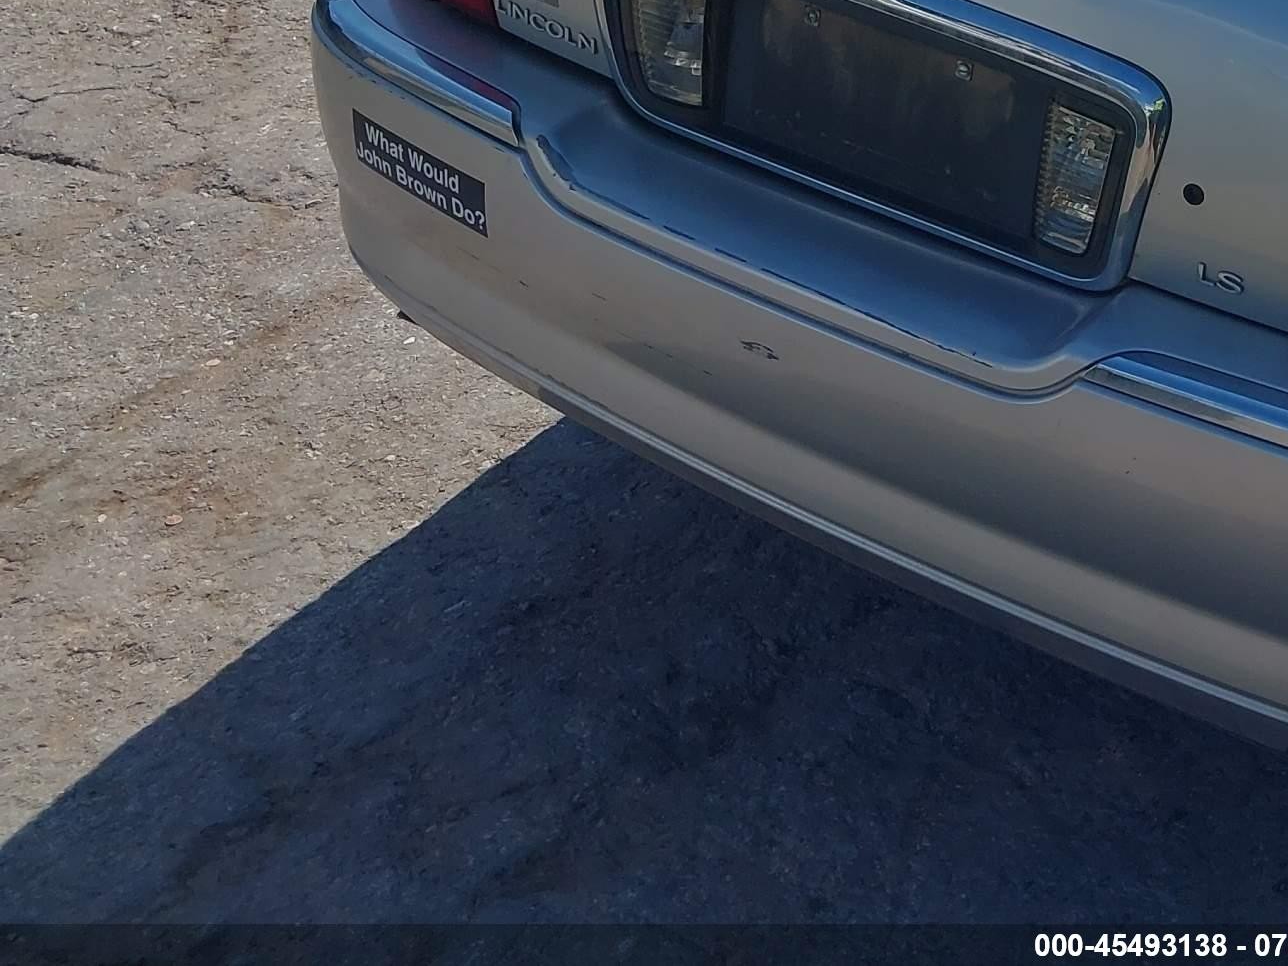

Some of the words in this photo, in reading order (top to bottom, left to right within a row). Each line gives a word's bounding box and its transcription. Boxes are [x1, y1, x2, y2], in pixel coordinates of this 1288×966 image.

[356, 140, 393, 178] John
[395, 163, 448, 211] Brown
[450, 196, 486, 231] Do?
[364, 121, 405, 163] What
[407, 146, 460, 195] Would
[1197, 261, 1244, 294] LS
